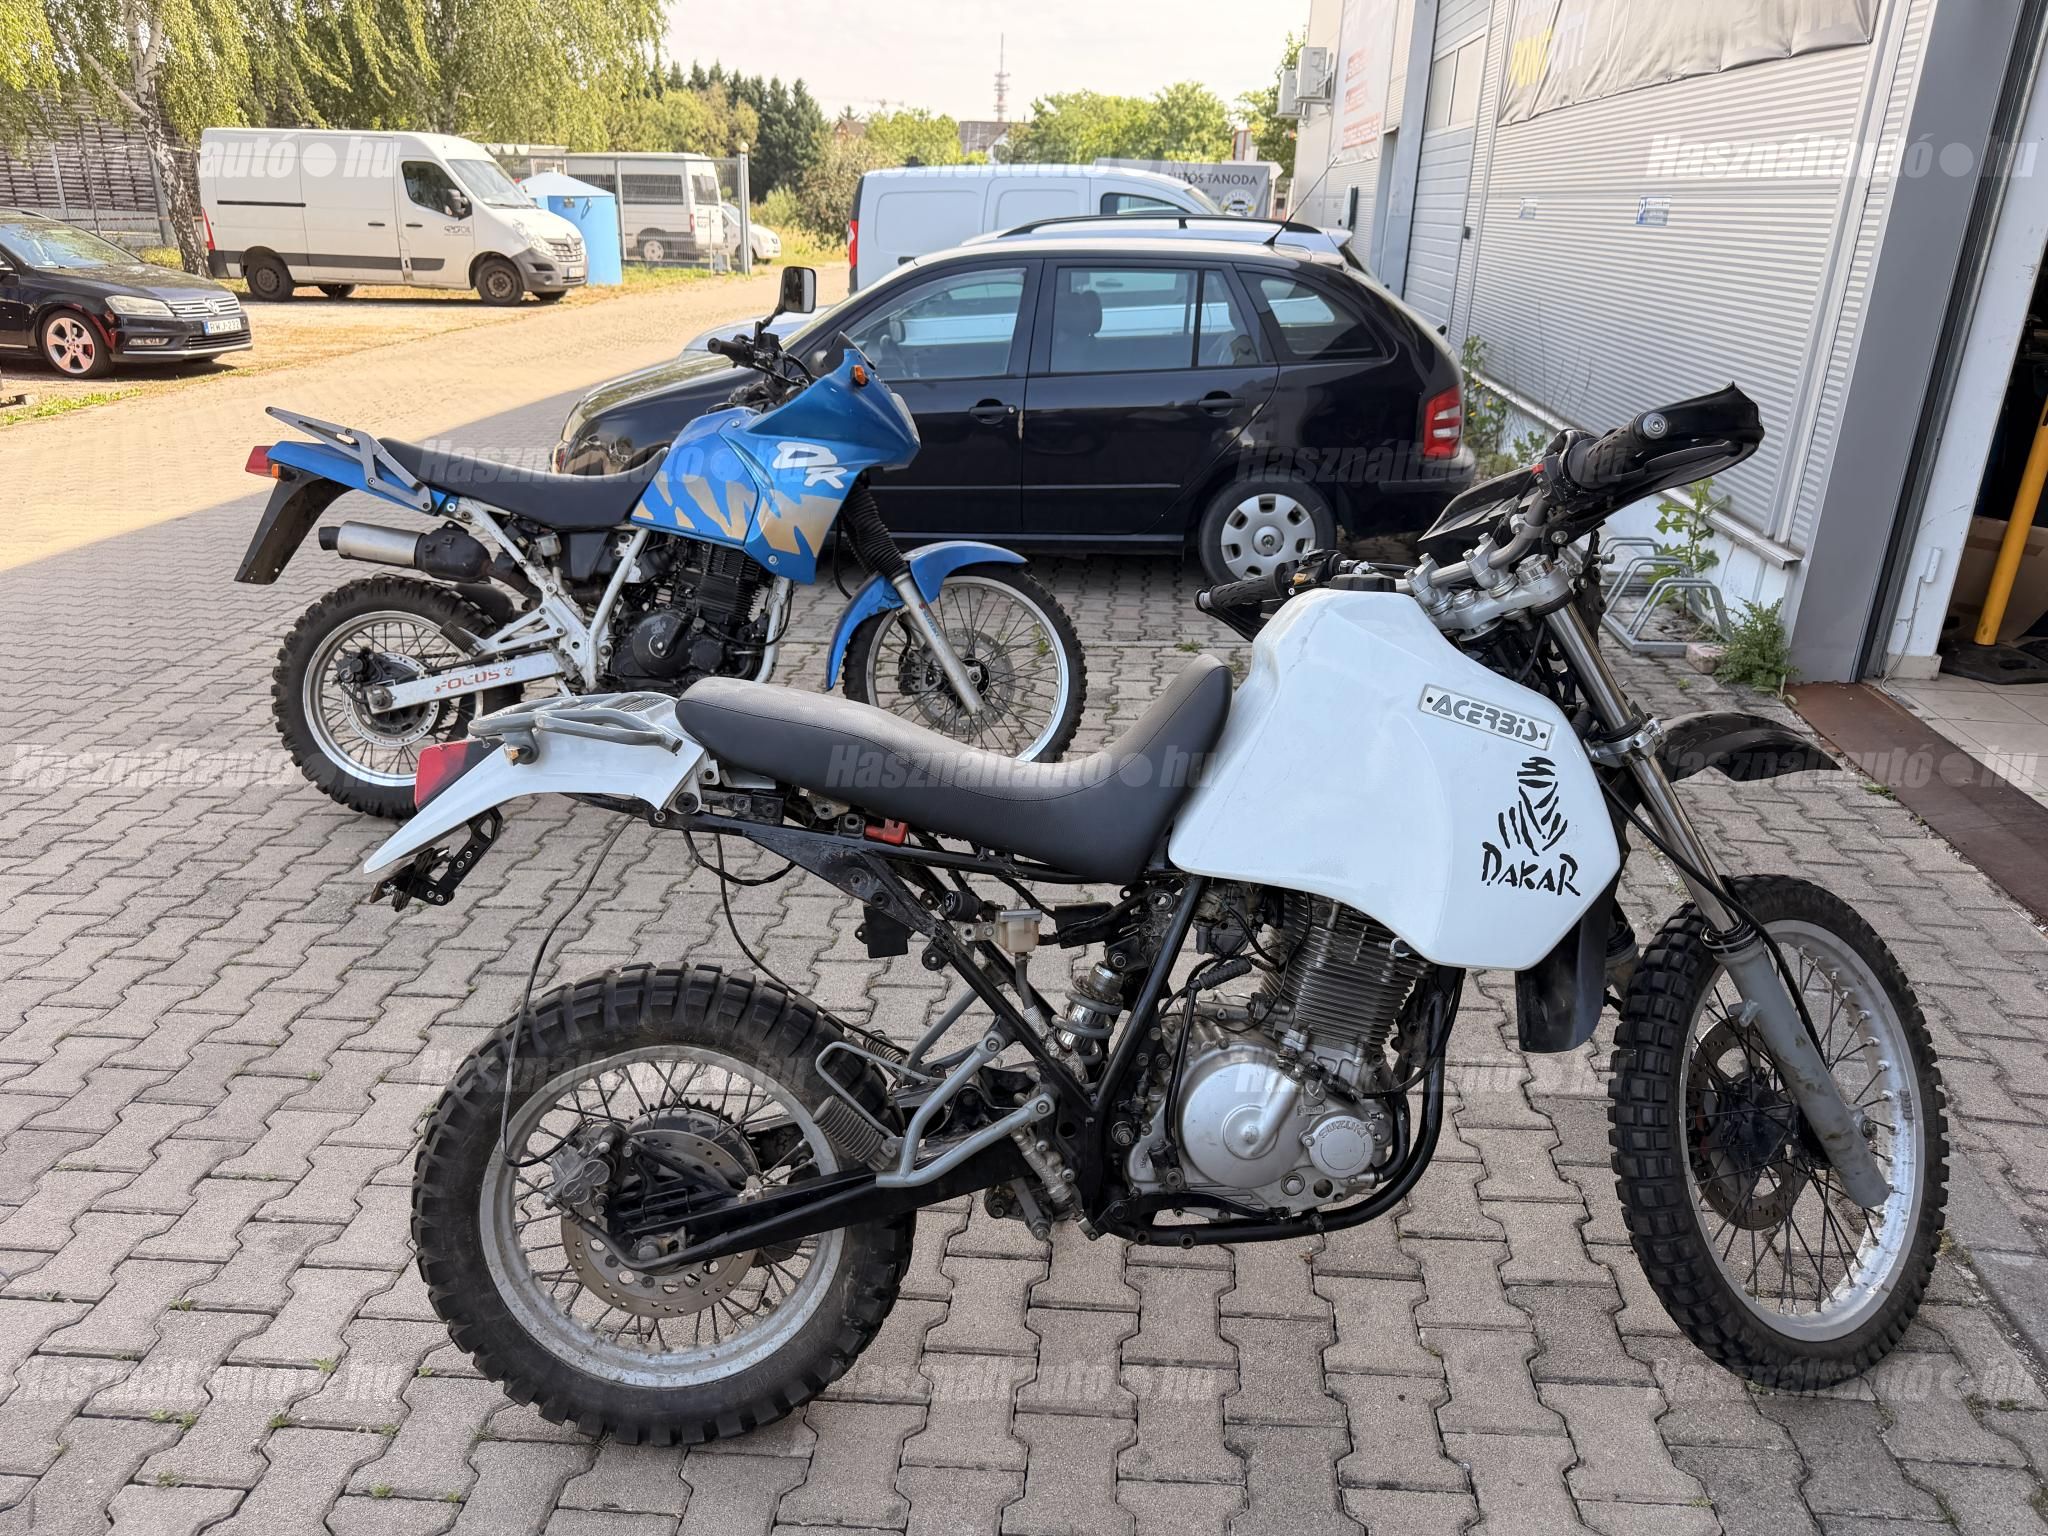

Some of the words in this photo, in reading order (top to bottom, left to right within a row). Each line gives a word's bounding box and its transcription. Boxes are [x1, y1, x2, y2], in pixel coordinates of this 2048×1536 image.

[1207, 172, 1258, 185] TANODA
[772, 441, 848, 489] DR
[1432, 694, 1539, 742] ACERBIS
[1481, 841, 1581, 896] DAKAR
[1319, 1119, 1369, 1139] SUZUKI
